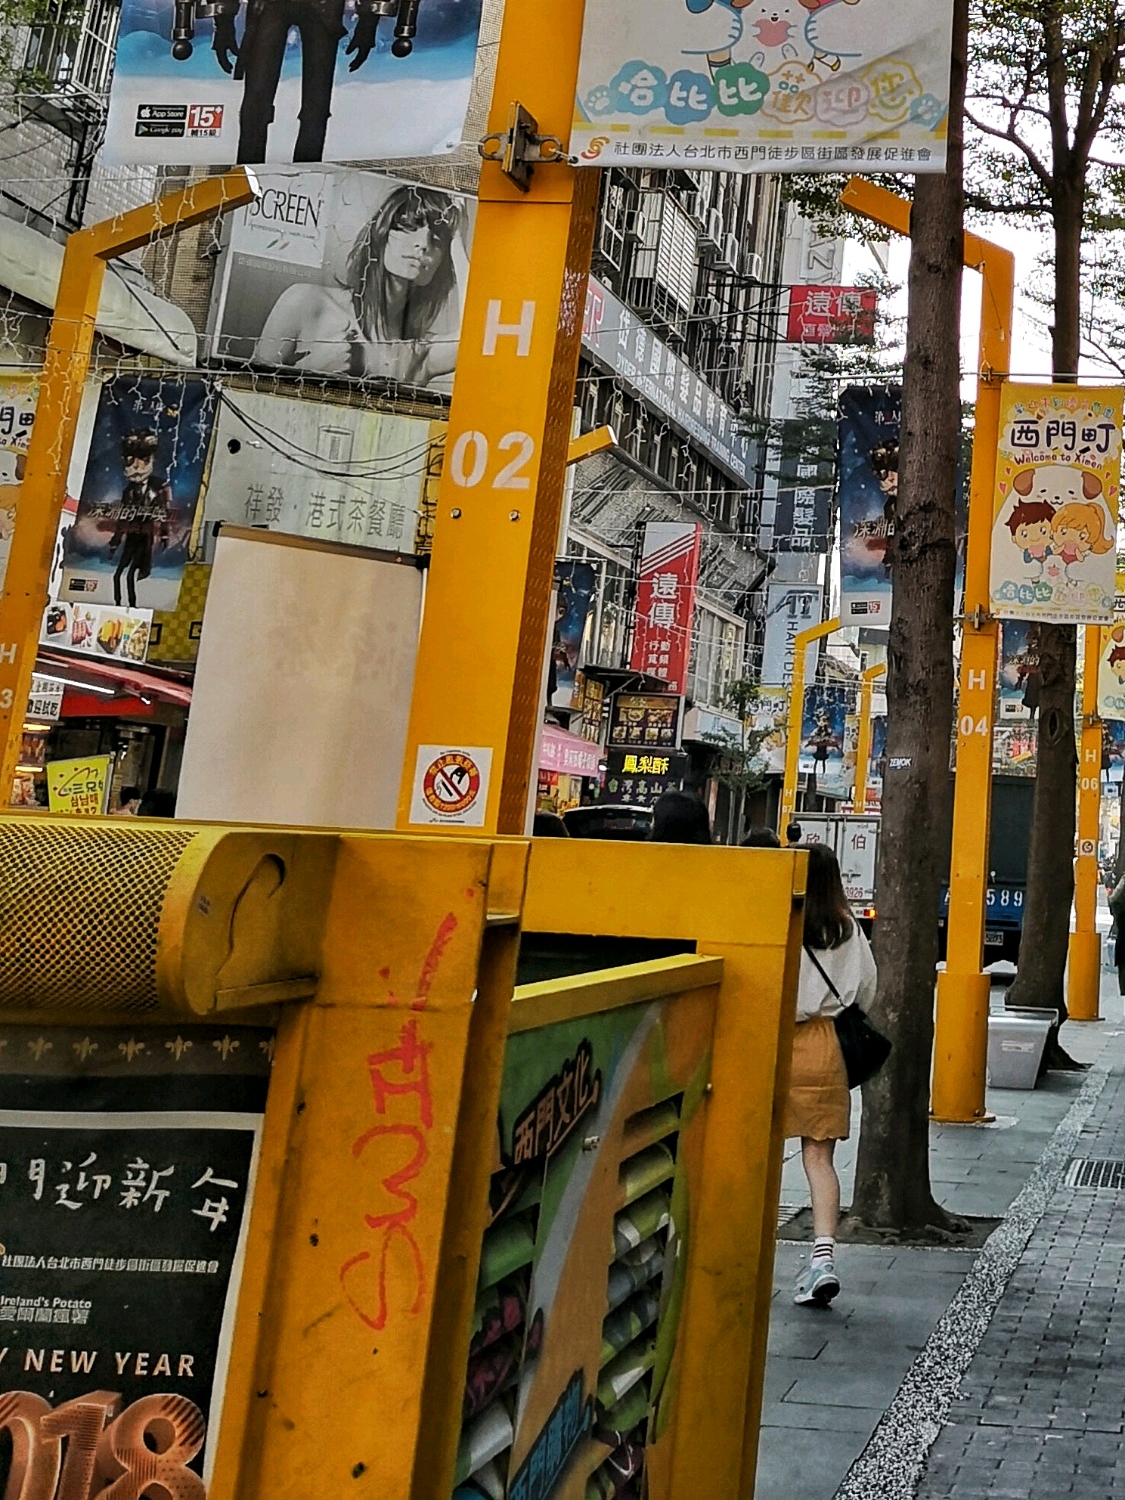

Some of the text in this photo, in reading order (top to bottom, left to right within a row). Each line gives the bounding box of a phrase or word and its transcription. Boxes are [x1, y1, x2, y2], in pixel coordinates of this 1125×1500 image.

[613, 141, 932, 162] 社團法人台北市西門徒步區街區發展促進會
[482, 301, 536, 358] H
[1011, 419, 1116, 452] 西門町
[451, 431, 535, 490] 02
[1014, 452, 1103, 470] Welcome to Ximen
[648, 572, 678, 630] 遠傳
[967, 669, 987, 691] H
[960, 715, 988, 736] 04
[1085, 749, 1097, 763] H
[1081, 779, 1099, 792] 06
[53, 1297, 92, 1309] Potato
[24, 1348, 195, 1378] NEW YEAR
